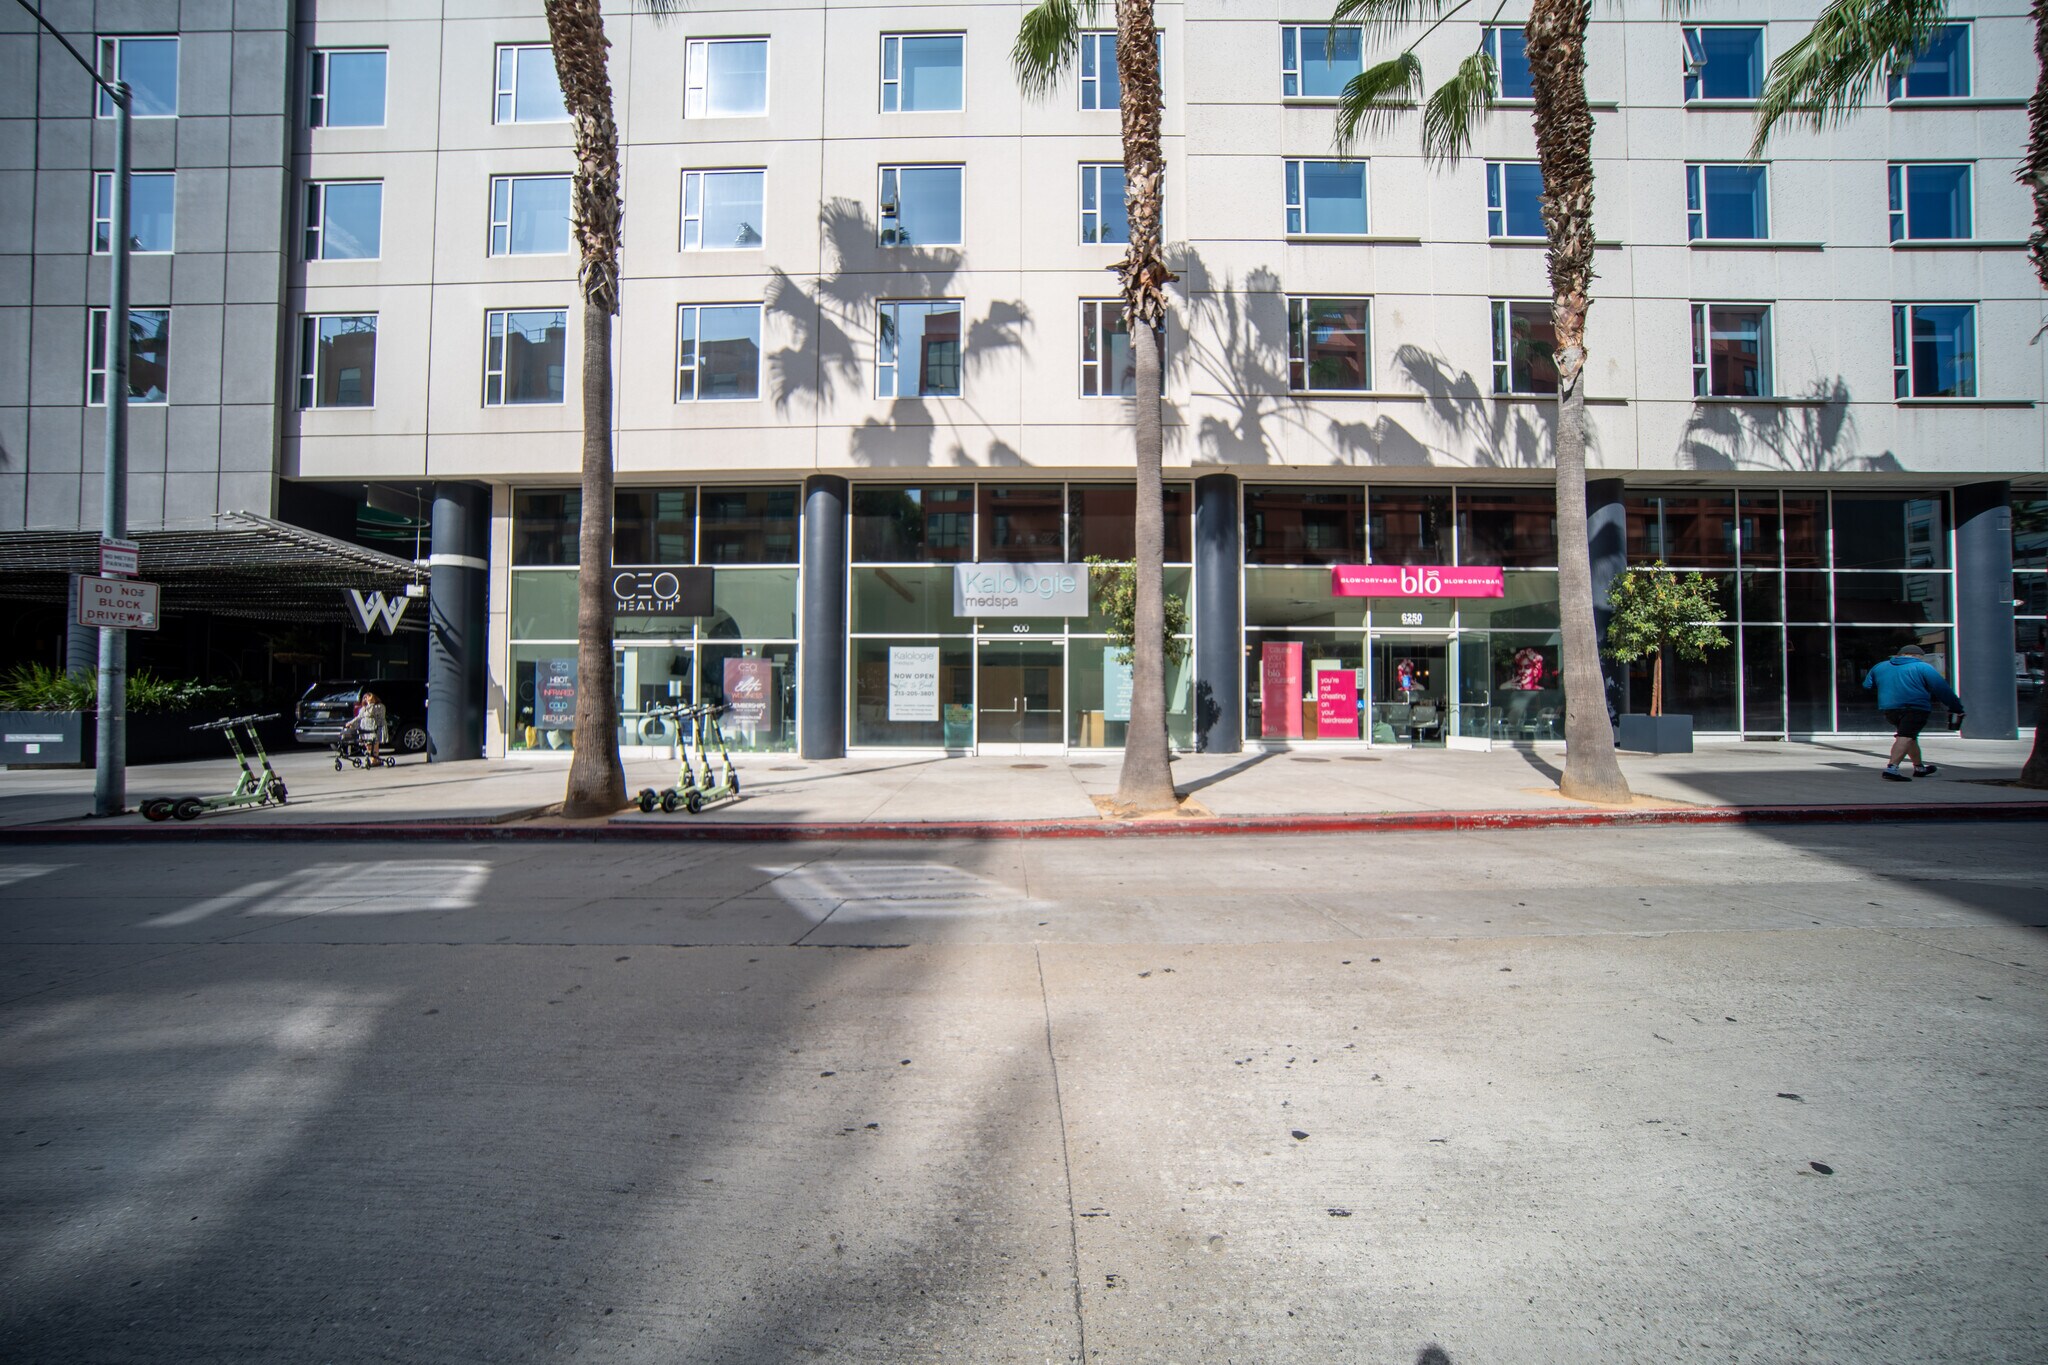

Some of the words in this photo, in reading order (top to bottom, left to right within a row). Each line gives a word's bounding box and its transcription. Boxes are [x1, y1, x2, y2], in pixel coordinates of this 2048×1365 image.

[114, 554, 136, 562] METRO
[105, 560, 134, 568] PARKING
[95, 585, 112, 594] DO
[965, 572, 1077, 599] Kalologie
[99, 598, 140, 609] BLOCK
[617, 601, 674, 611] HEALTH
[965, 595, 1019, 609] medspa
[87, 610, 146, 622] DRIVEWA
[341, 588, 410, 635] W
[1401, 613, 1422, 621] 6250
[894, 651, 935, 662] Kalologie
[544, 689, 574, 697] INFRARED
